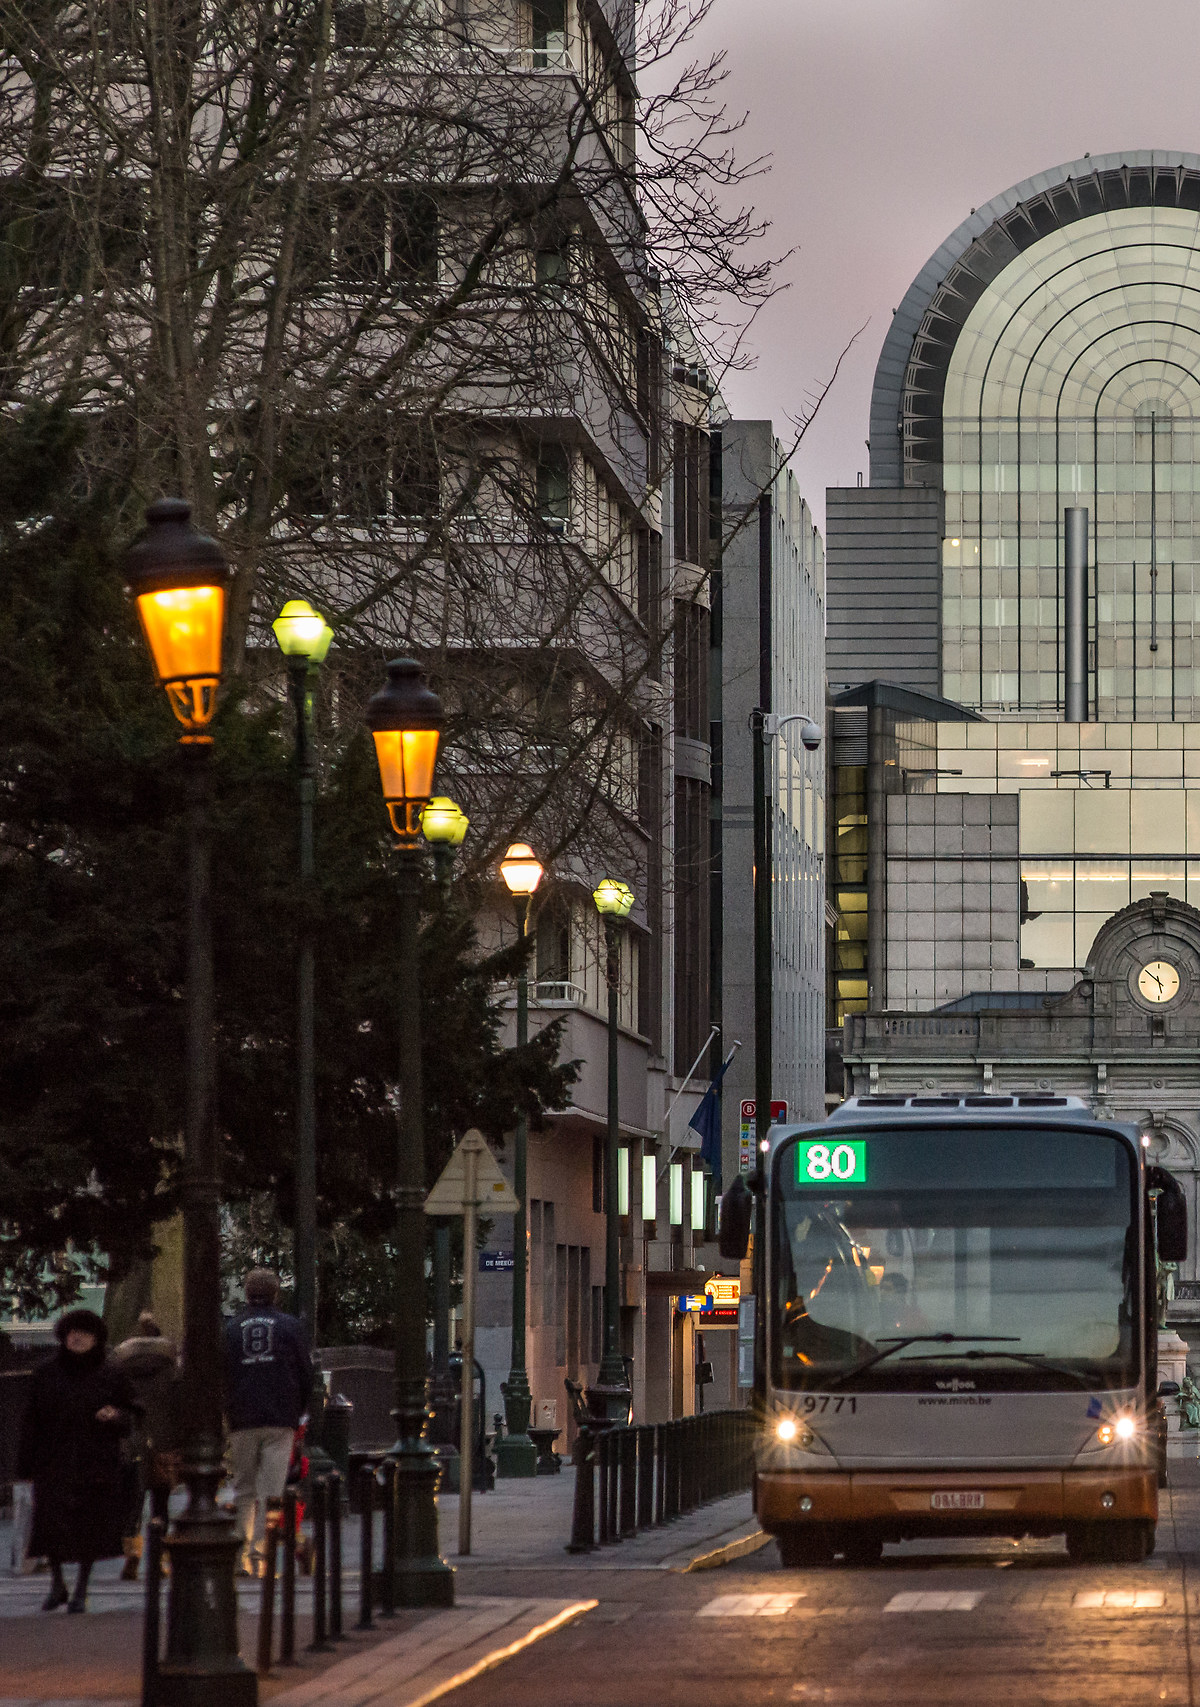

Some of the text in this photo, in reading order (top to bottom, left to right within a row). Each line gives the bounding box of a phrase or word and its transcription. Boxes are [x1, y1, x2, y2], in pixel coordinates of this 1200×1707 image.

[806, 1144, 856, 1180] 80
[804, 1396, 856, 1414] 9771
[918, 1396, 991, 1406] www.mivb.be
